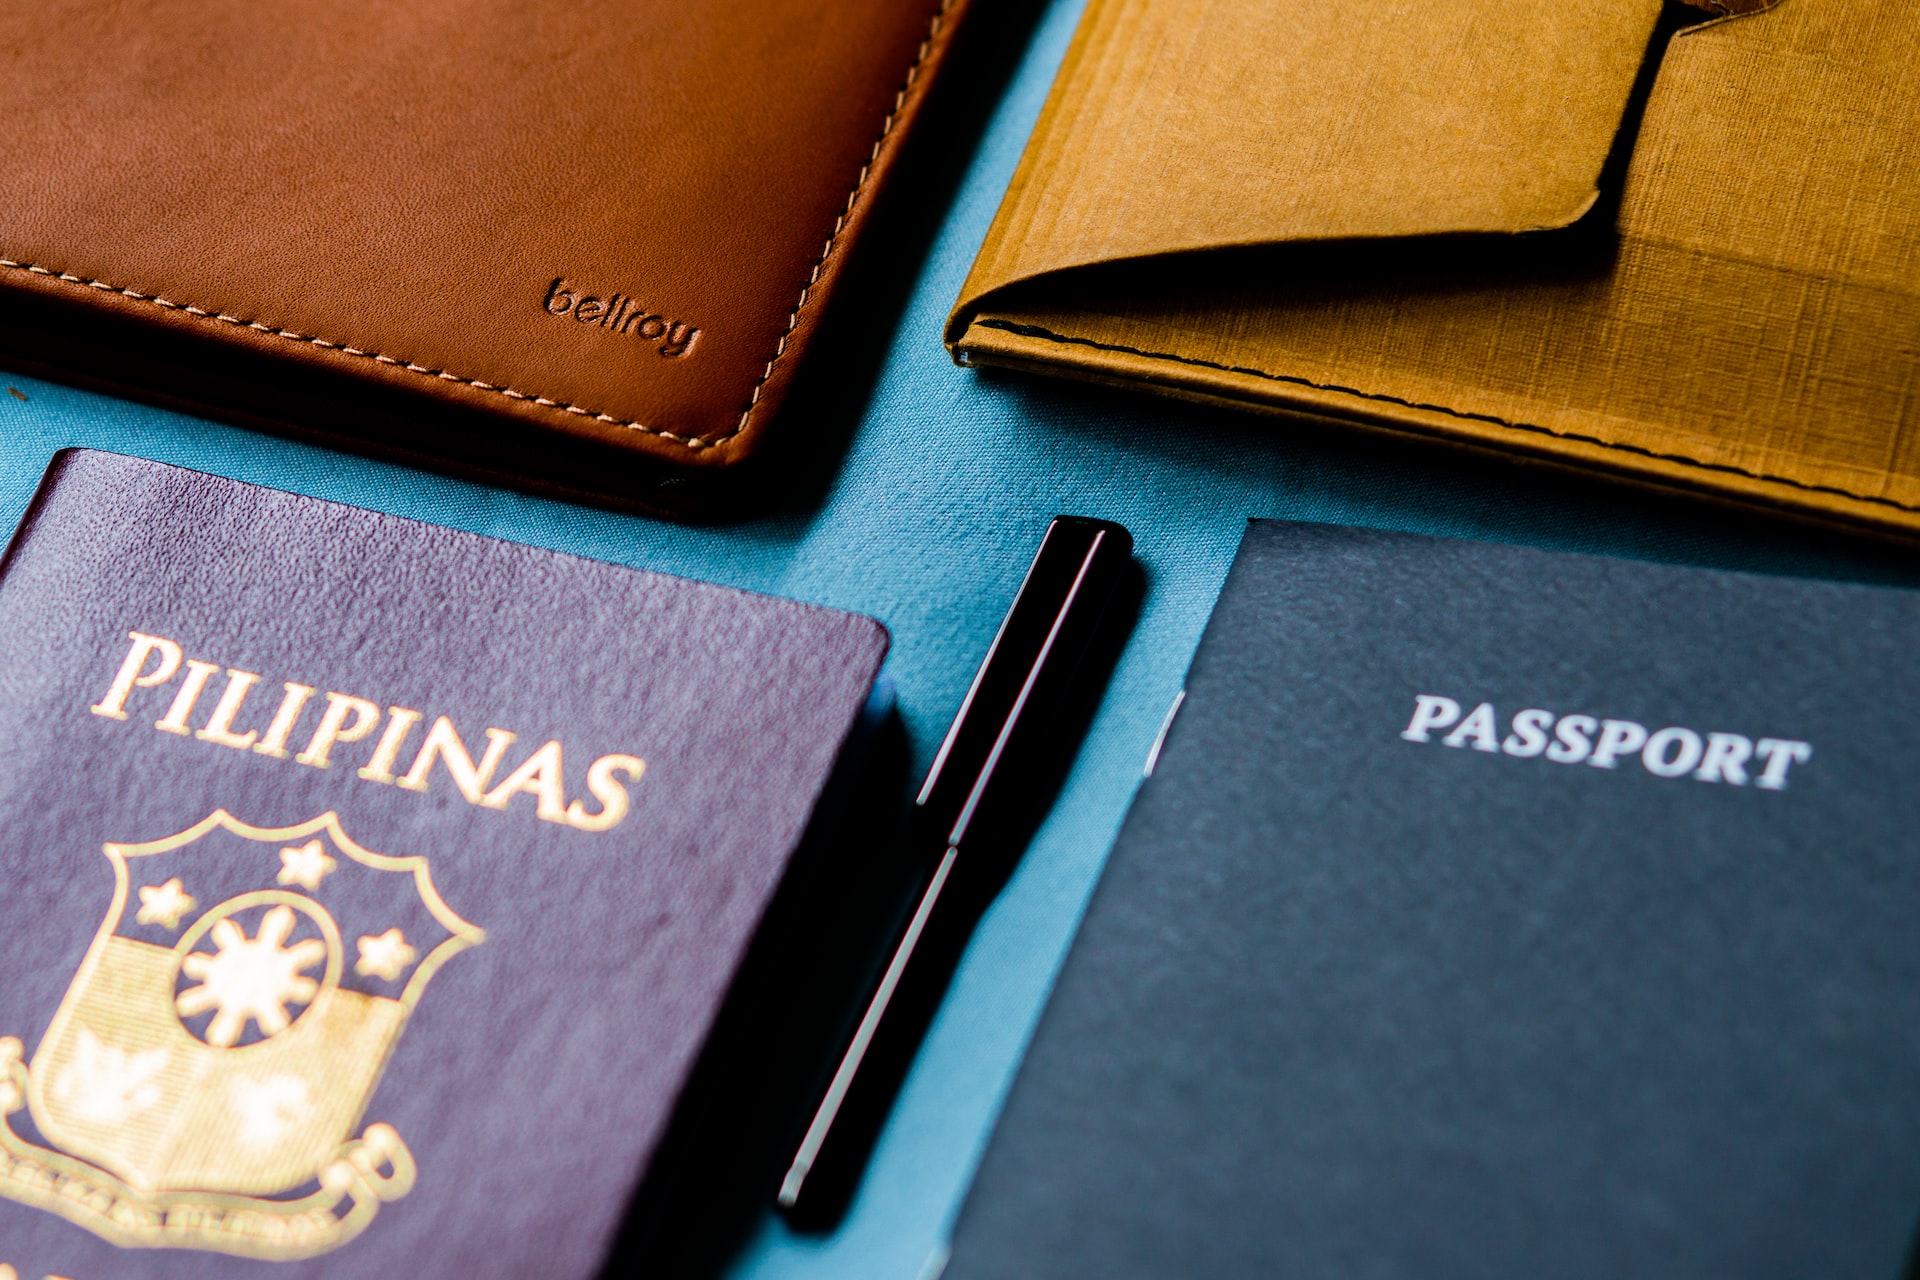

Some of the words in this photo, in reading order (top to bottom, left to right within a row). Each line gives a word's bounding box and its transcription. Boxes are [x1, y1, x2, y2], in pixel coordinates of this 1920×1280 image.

[543, 277, 701, 358] bellroy
[91, 631, 646, 831] PILIPINAS
[1401, 694, 1812, 790] PASSPORT
